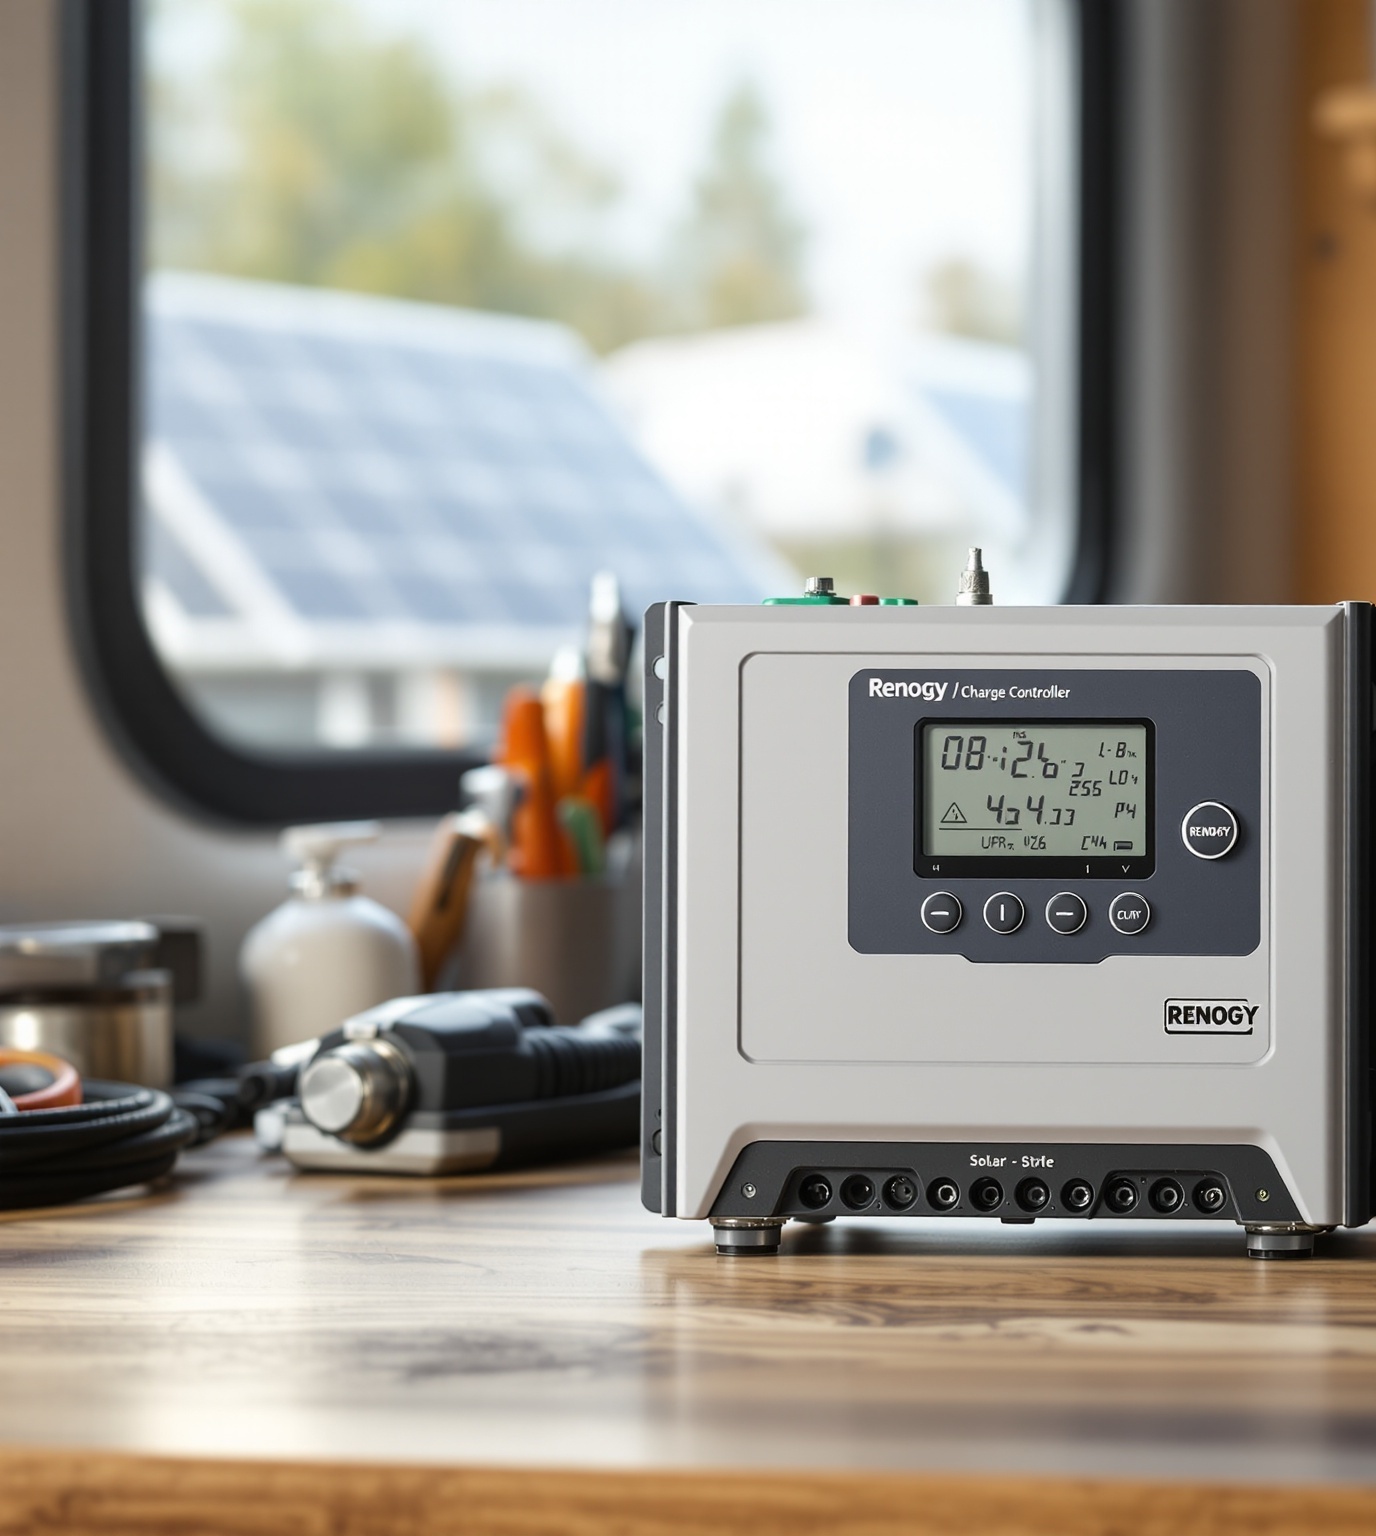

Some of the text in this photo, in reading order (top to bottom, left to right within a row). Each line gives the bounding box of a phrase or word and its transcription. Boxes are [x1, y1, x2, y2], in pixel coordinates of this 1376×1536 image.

[868, 677, 949, 702] Renogy
[961, 685, 1006, 702] Charge
[1009, 685, 1071, 699] Controller
[1167, 1005, 1260, 1026] RENOGY
